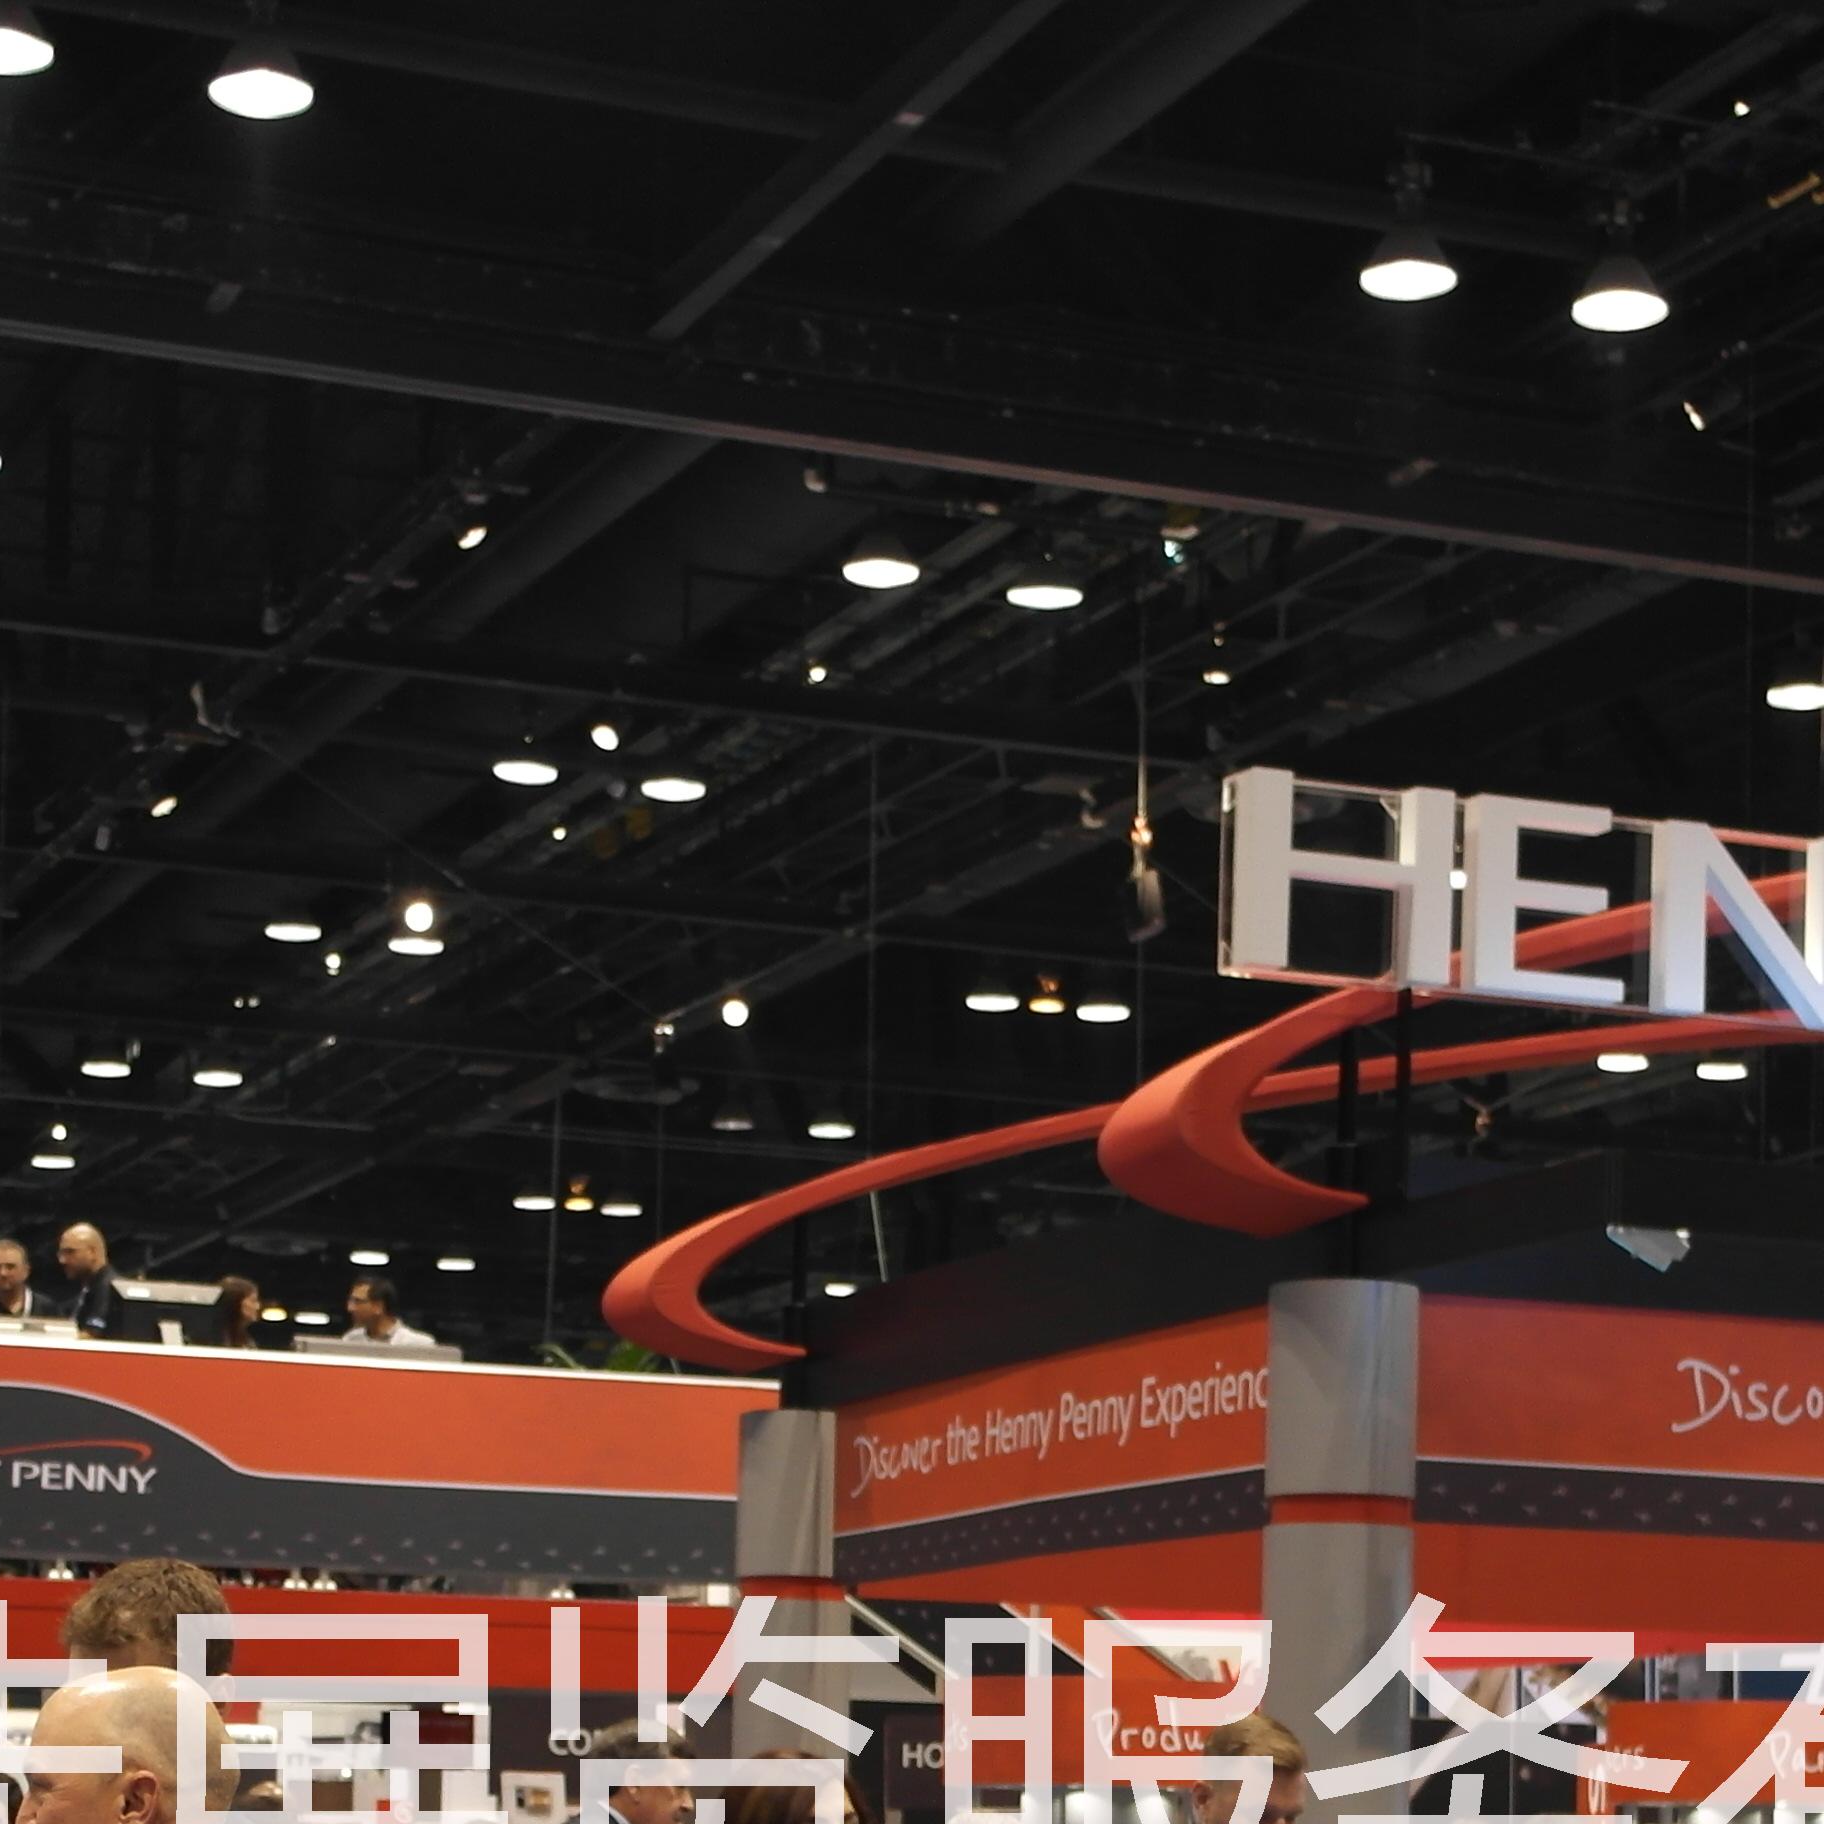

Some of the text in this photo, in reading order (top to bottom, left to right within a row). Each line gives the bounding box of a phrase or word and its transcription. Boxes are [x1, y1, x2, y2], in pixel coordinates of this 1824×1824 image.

[11, 1461, 156, 1495] PENNY
[850, 1431, 943, 1498] Discover
[946, 1417, 979, 1465] the
[984, 1409, 1053, 1459] Henny
[1058, 1390, 1134, 1447] Penny
